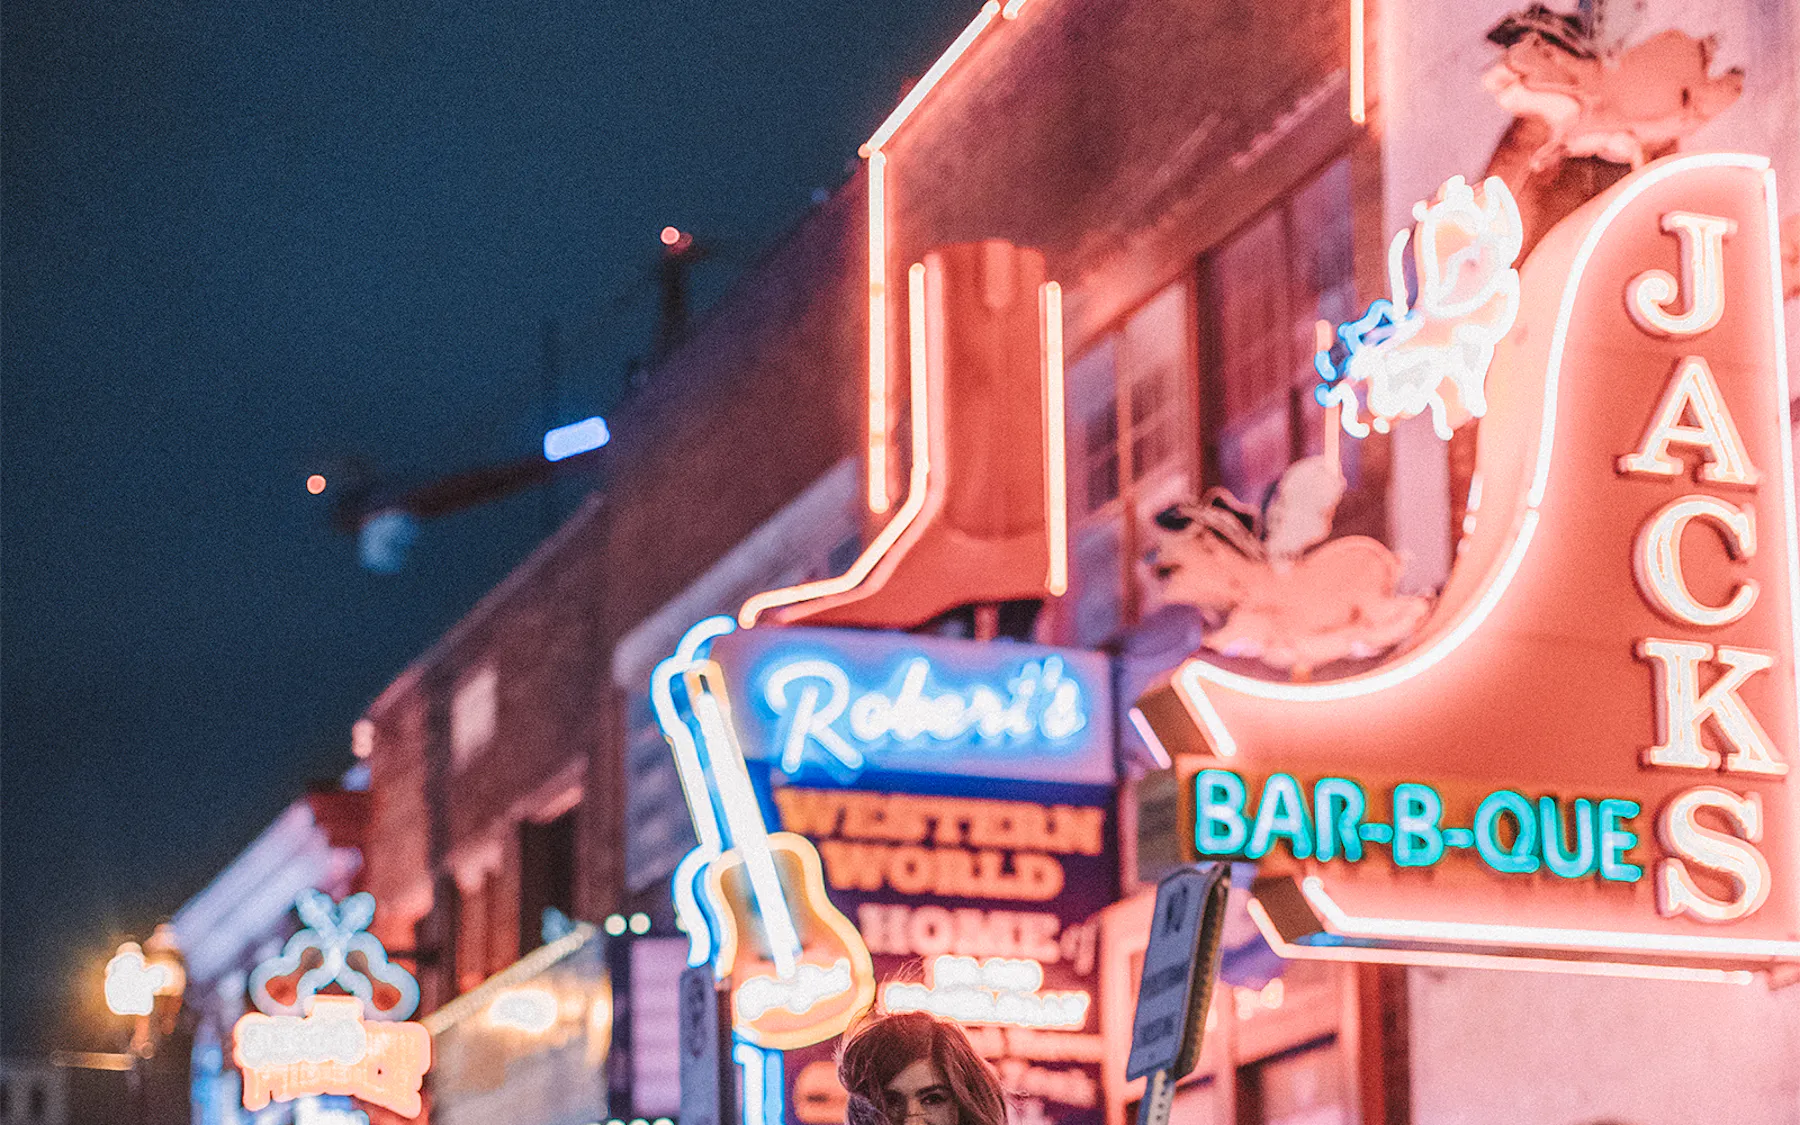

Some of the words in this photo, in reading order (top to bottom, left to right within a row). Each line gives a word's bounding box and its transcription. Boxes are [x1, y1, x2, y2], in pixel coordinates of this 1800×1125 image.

[1618, 211, 1789, 922] JACKS
[766, 655, 1086, 773] Robert's
[775, 788, 1106, 855] WESTERN
[1194, 768, 1644, 884] BAR-B-QUE
[821, 841, 1066, 902] WORLD
[857, 904, 1061, 963] HOME
